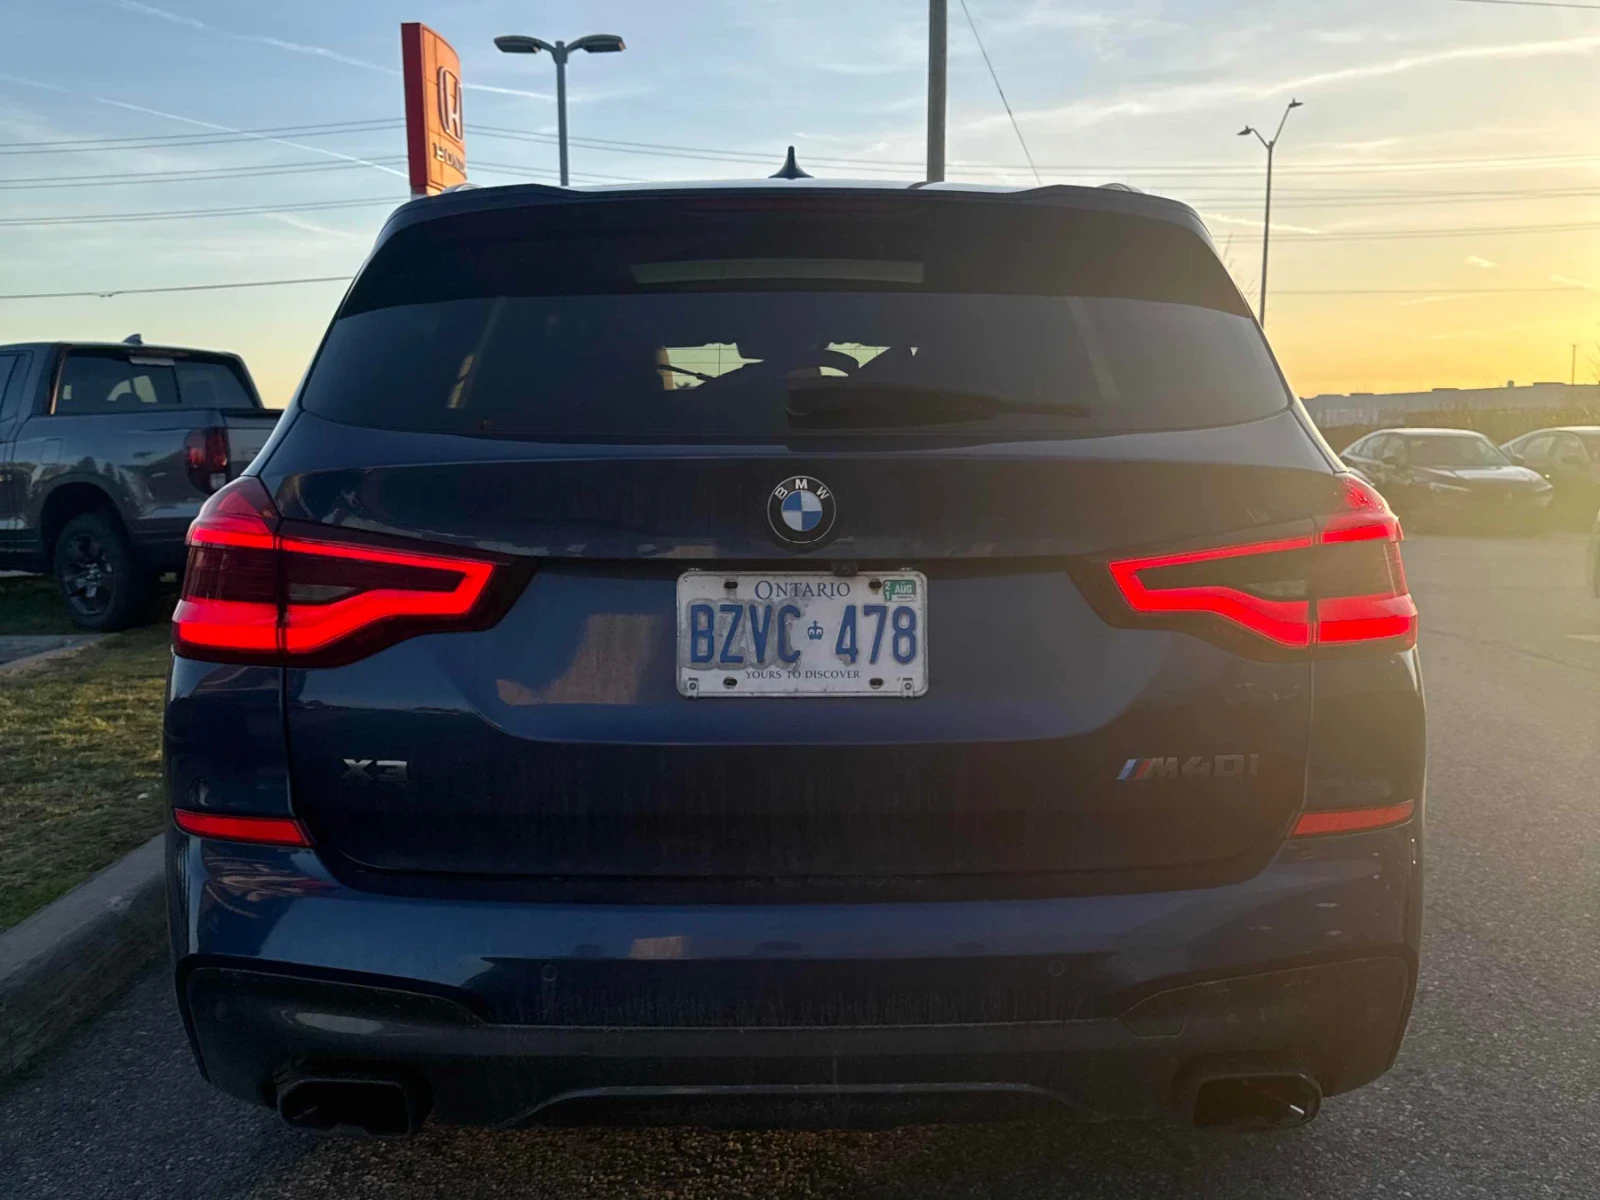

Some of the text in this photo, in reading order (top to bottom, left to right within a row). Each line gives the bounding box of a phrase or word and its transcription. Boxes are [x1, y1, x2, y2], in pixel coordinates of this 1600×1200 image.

[774, 478, 830, 500] BMW
[754, 580, 851, 600] ONTARIO
[894, 584, 913, 594] AUG
[690, 604, 918, 665] BZVC 478
[745, 670, 861, 679] YOURS TO DISCOVER
[340, 758, 408, 781] X3
